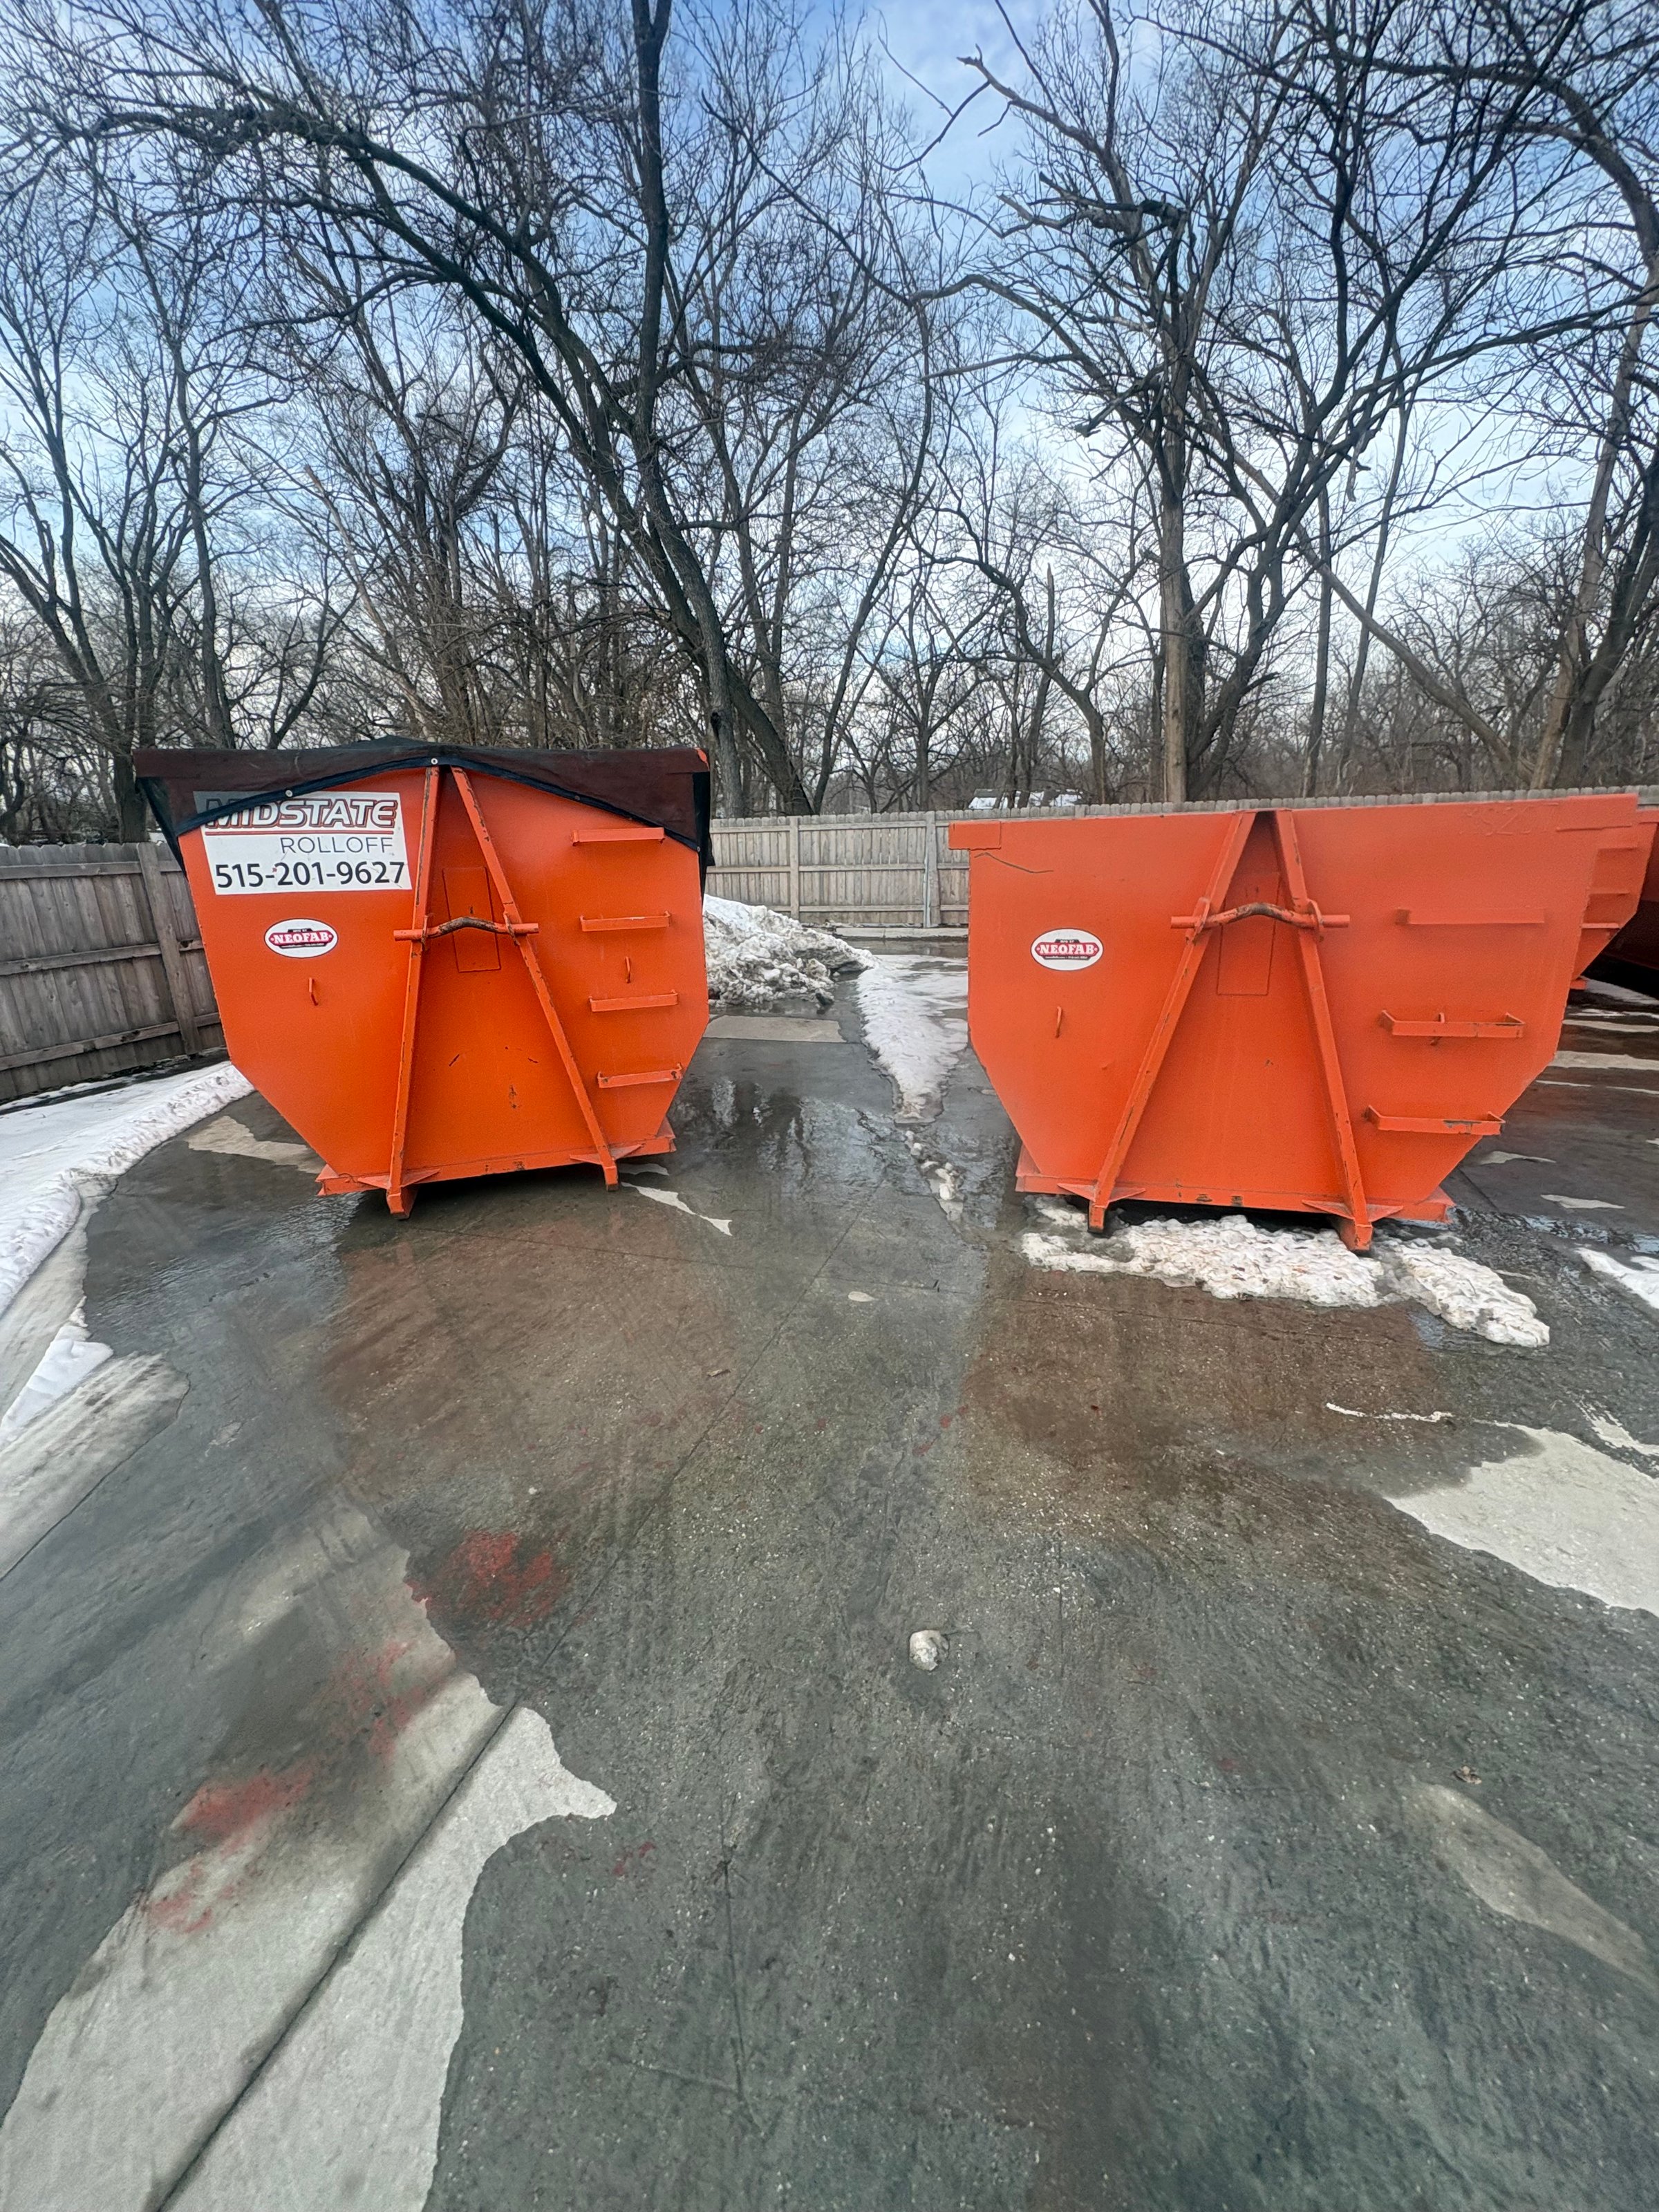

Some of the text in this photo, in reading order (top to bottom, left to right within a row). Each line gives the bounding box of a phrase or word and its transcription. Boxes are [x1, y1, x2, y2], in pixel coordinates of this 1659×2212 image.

[279, 836, 393, 854] ROLLOFF
[215, 861, 405, 888] 515-201-9627
[273, 931, 330, 944] NEOFAB
[1039, 944, 1094, 955] NEOFAB
